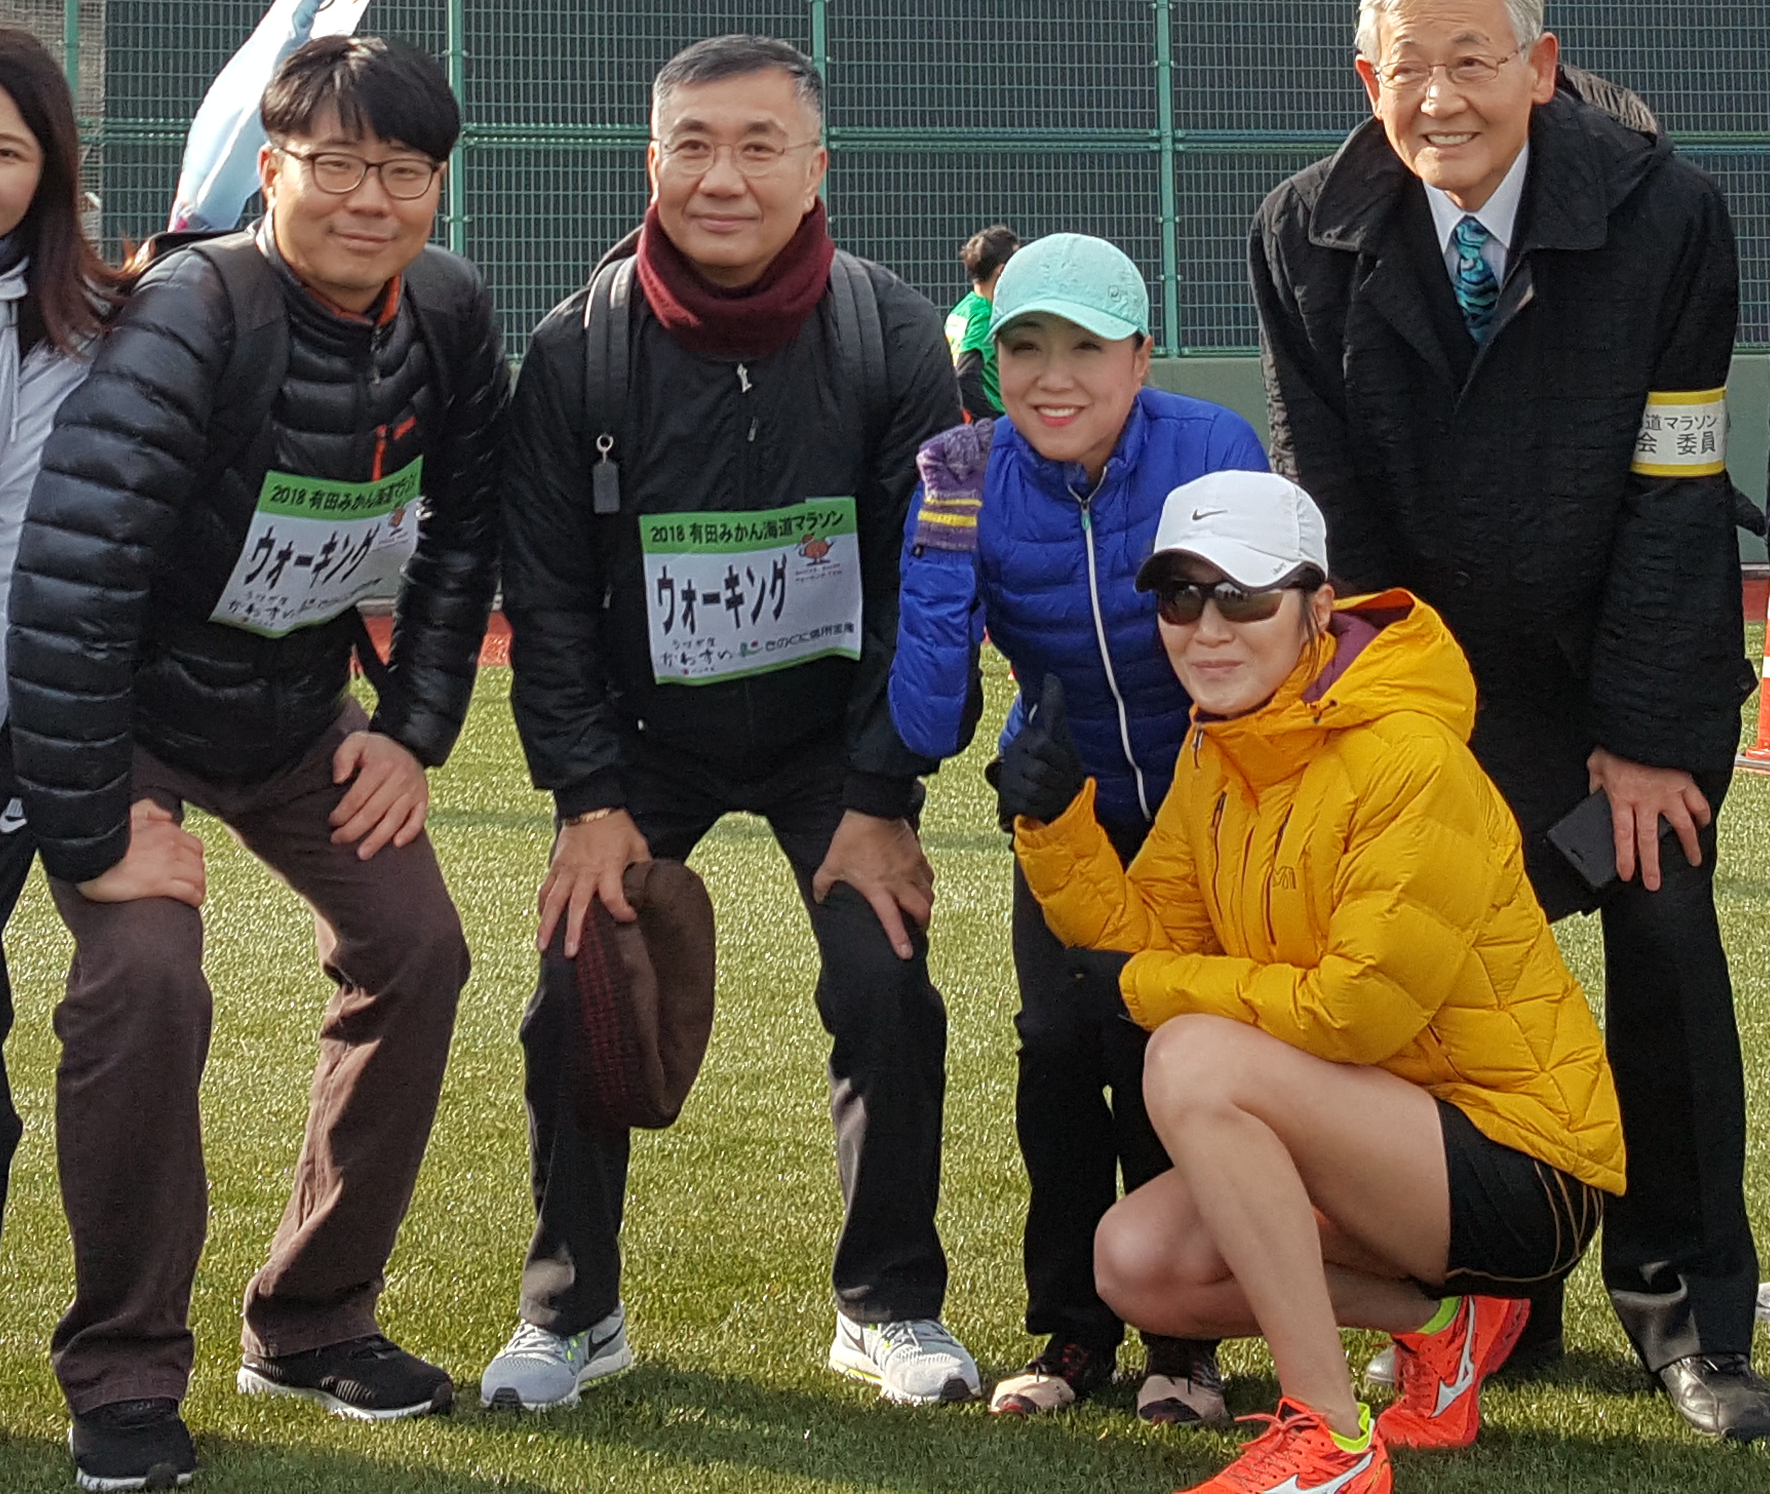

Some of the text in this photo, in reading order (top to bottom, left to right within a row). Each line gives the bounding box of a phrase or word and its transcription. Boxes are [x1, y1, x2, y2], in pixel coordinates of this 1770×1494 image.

[1644, 413, 1718, 432] 道マラソン
[1676, 431, 1716, 455] 委員
[269, 484, 307, 505] 2018
[651, 525, 685, 543] 2018
[243, 521, 381, 591] ウォーキング
[656, 553, 788, 636] ウォーキング
